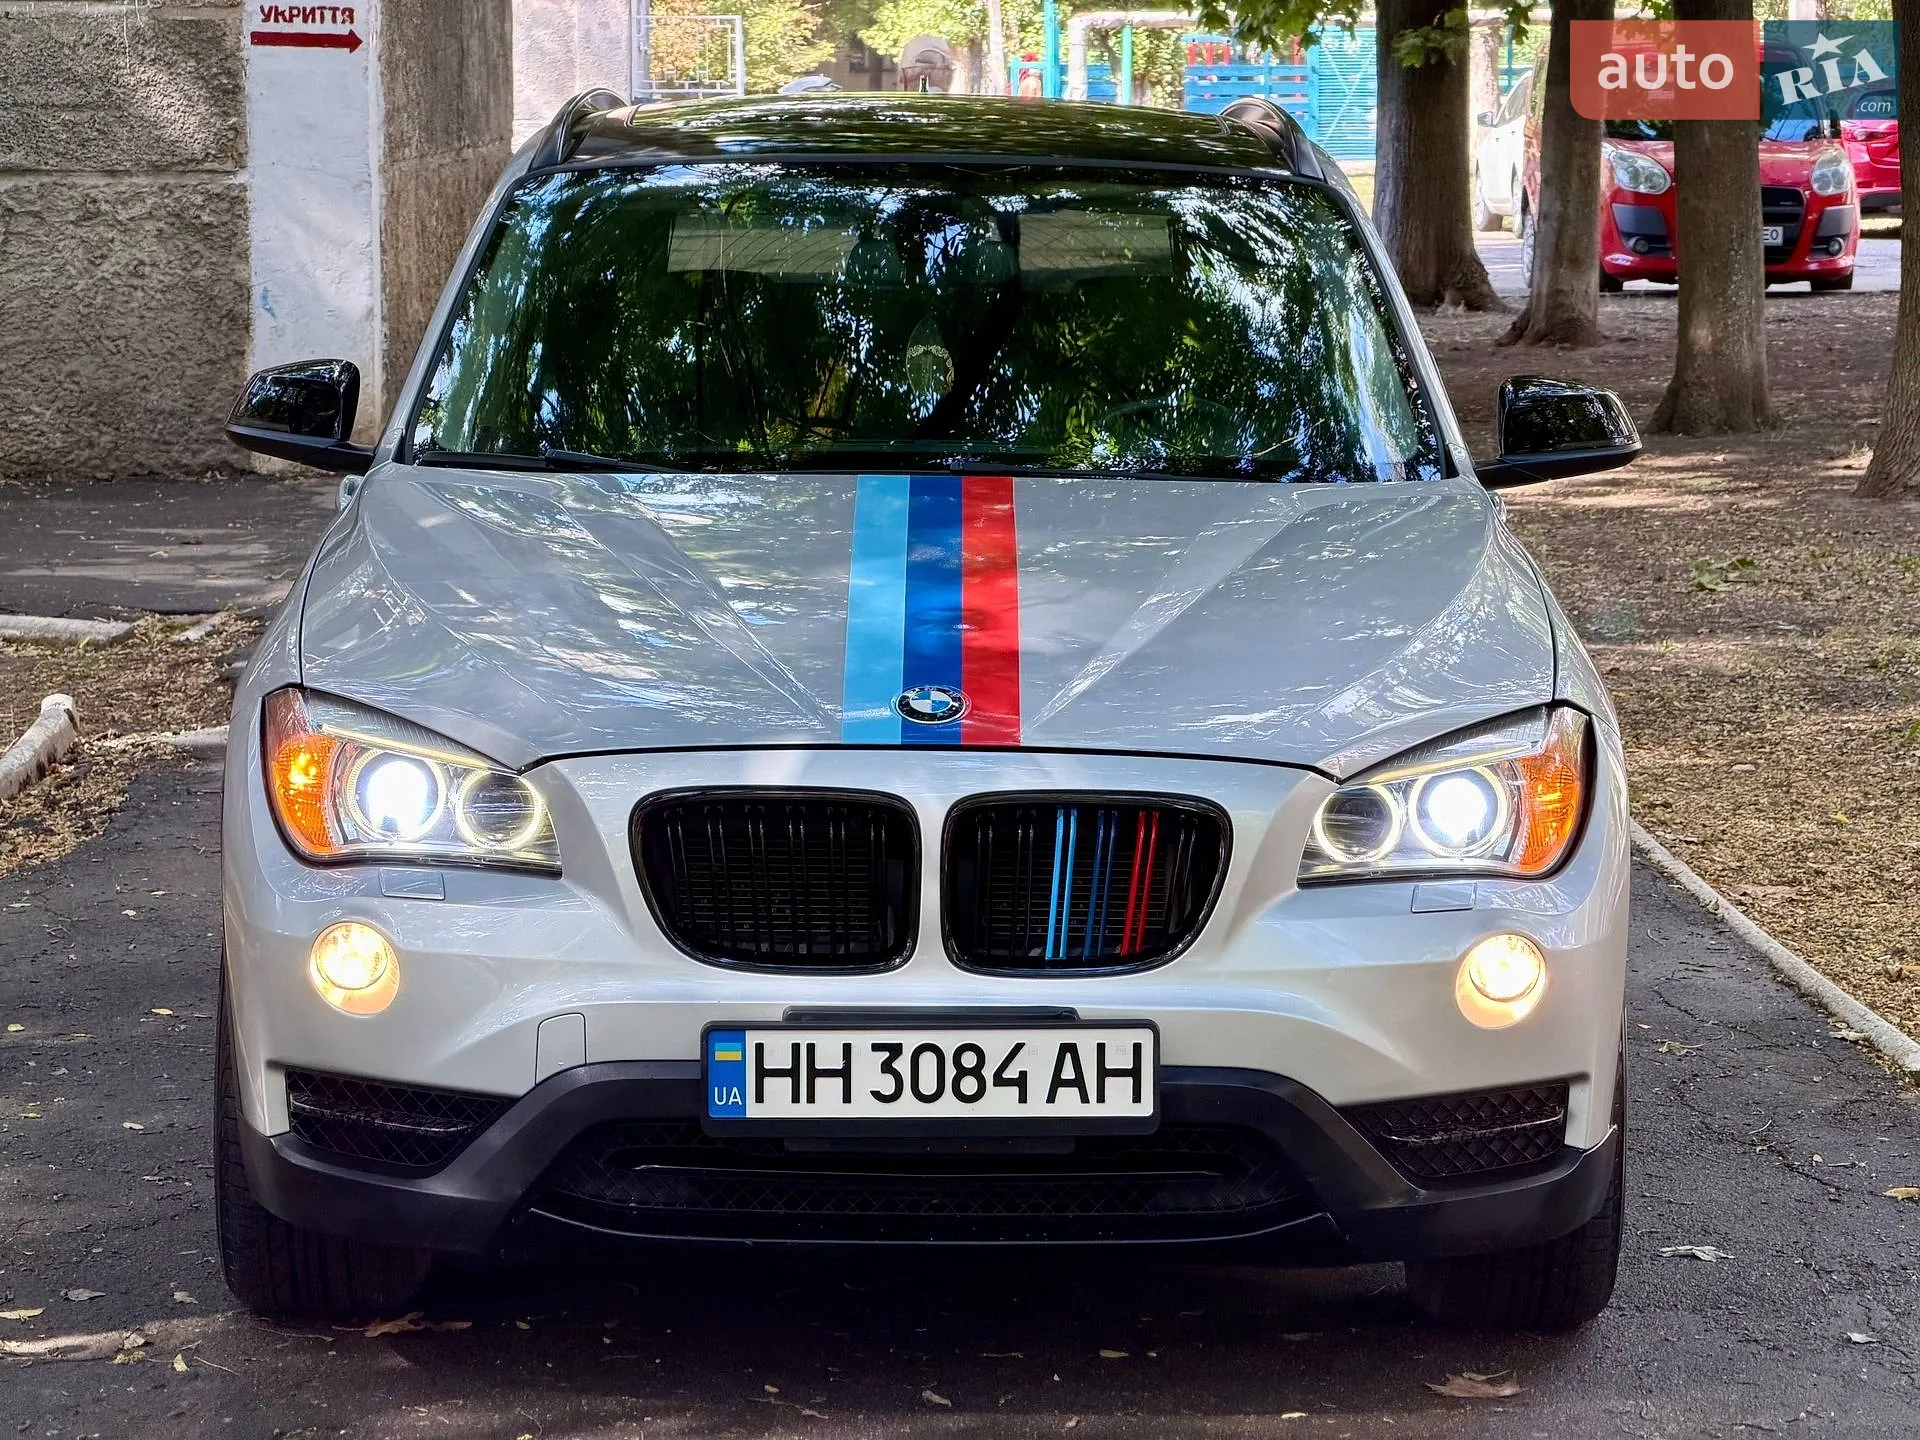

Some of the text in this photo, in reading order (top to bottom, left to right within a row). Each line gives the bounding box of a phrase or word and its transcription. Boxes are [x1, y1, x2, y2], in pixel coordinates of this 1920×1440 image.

[754, 1042, 1142, 1104] HH 3084 AH
[714, 1087, 742, 1106] UA
